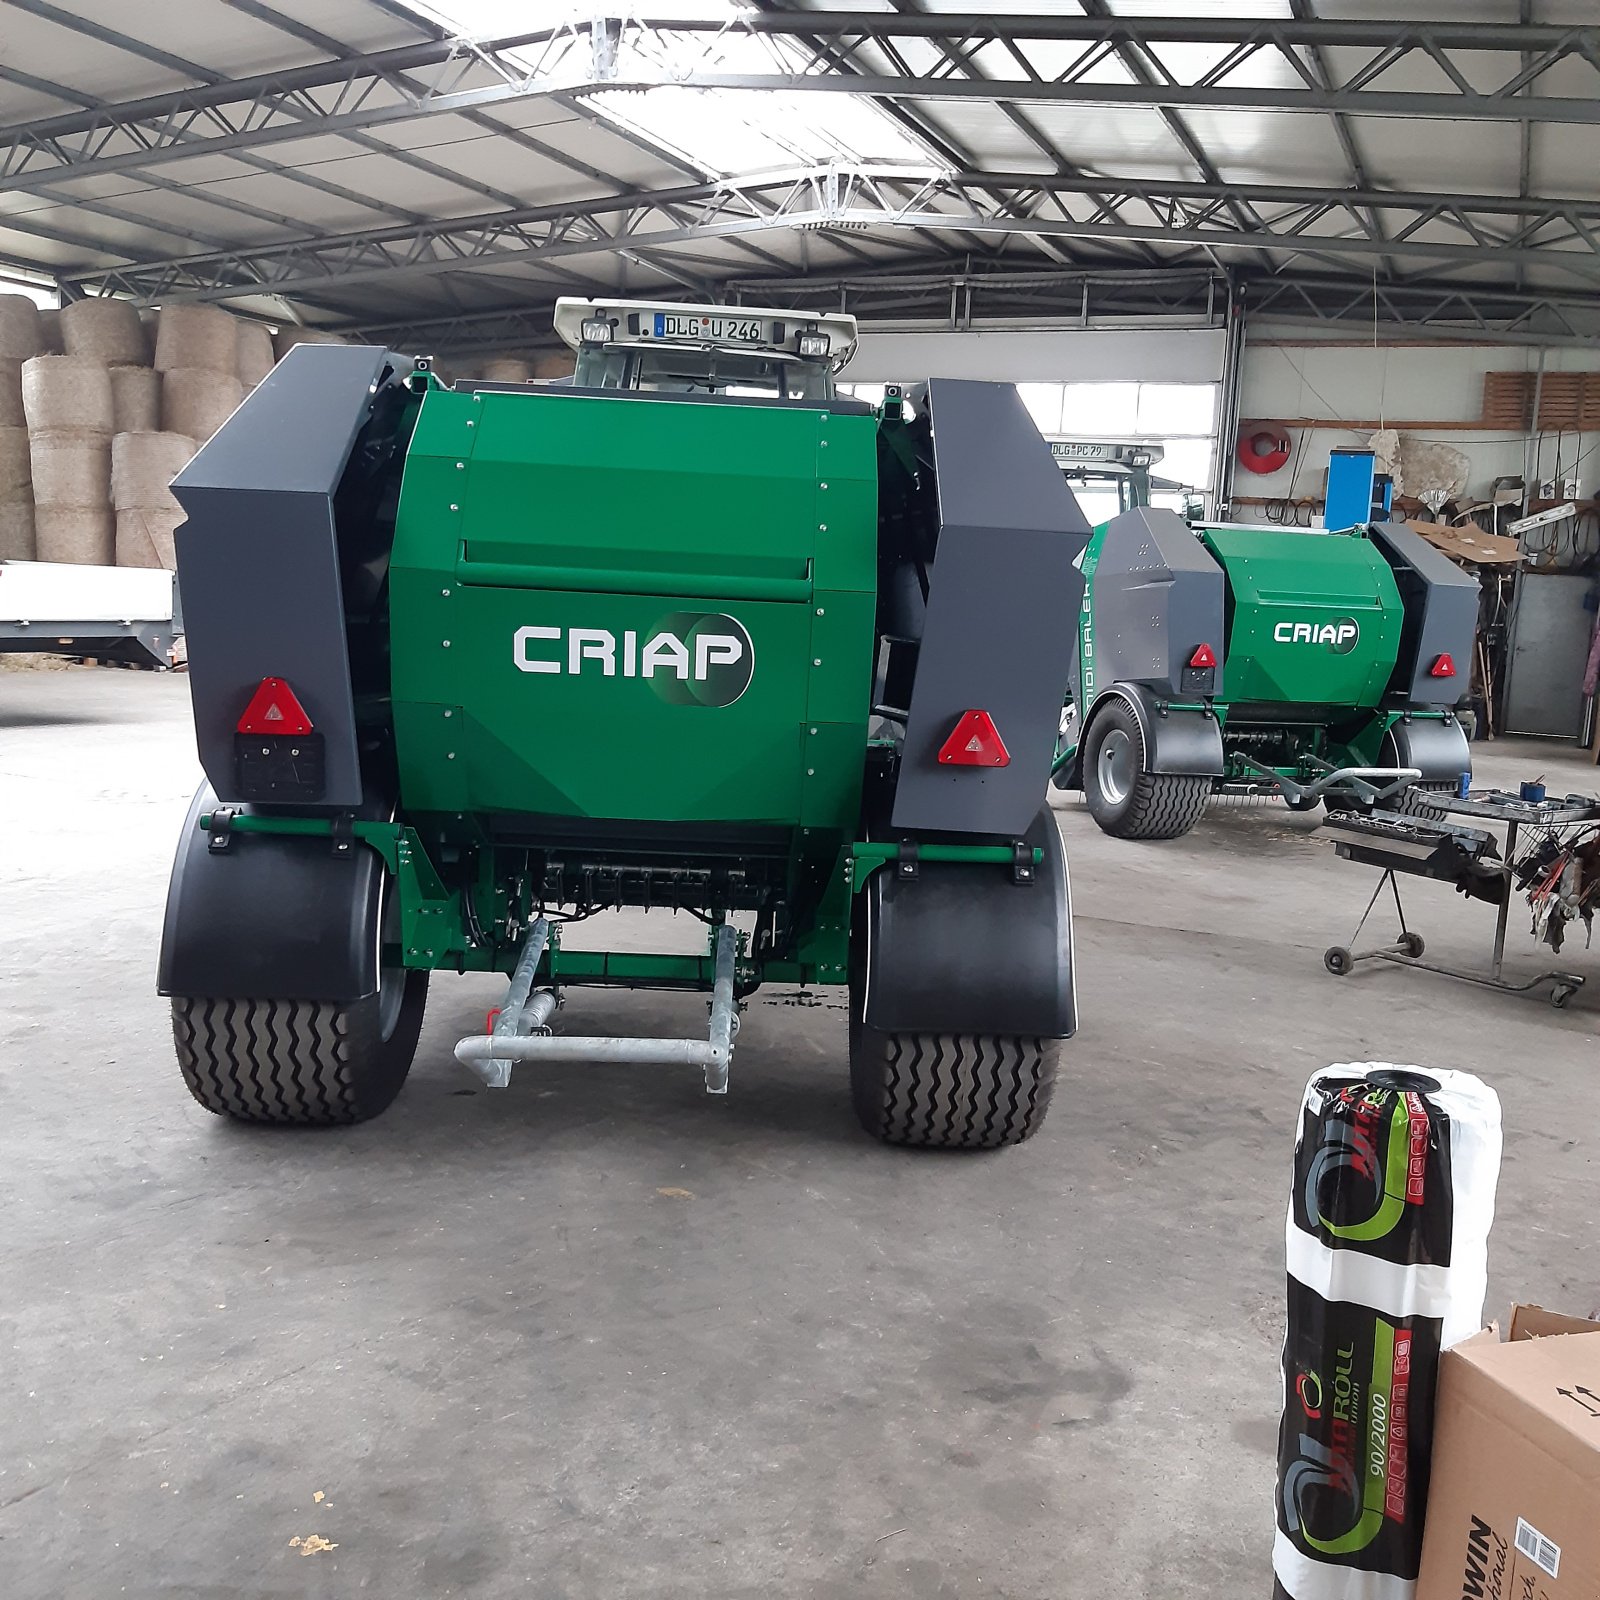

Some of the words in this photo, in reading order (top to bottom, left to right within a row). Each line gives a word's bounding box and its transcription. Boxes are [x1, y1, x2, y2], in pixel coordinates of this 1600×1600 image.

[665, 317, 699, 336] DLG
[711, 319, 723, 337] U
[727, 321, 760, 340] 246
[1052, 444, 1070, 455] DLG
[1076, 445, 1089, 456] PC
[1090, 446, 1102, 456] 79
[1273, 622, 1356, 645] CRIAP
[513, 625, 743, 681] CRIAP
[1370, 1393, 1387, 1478] 90/2000
